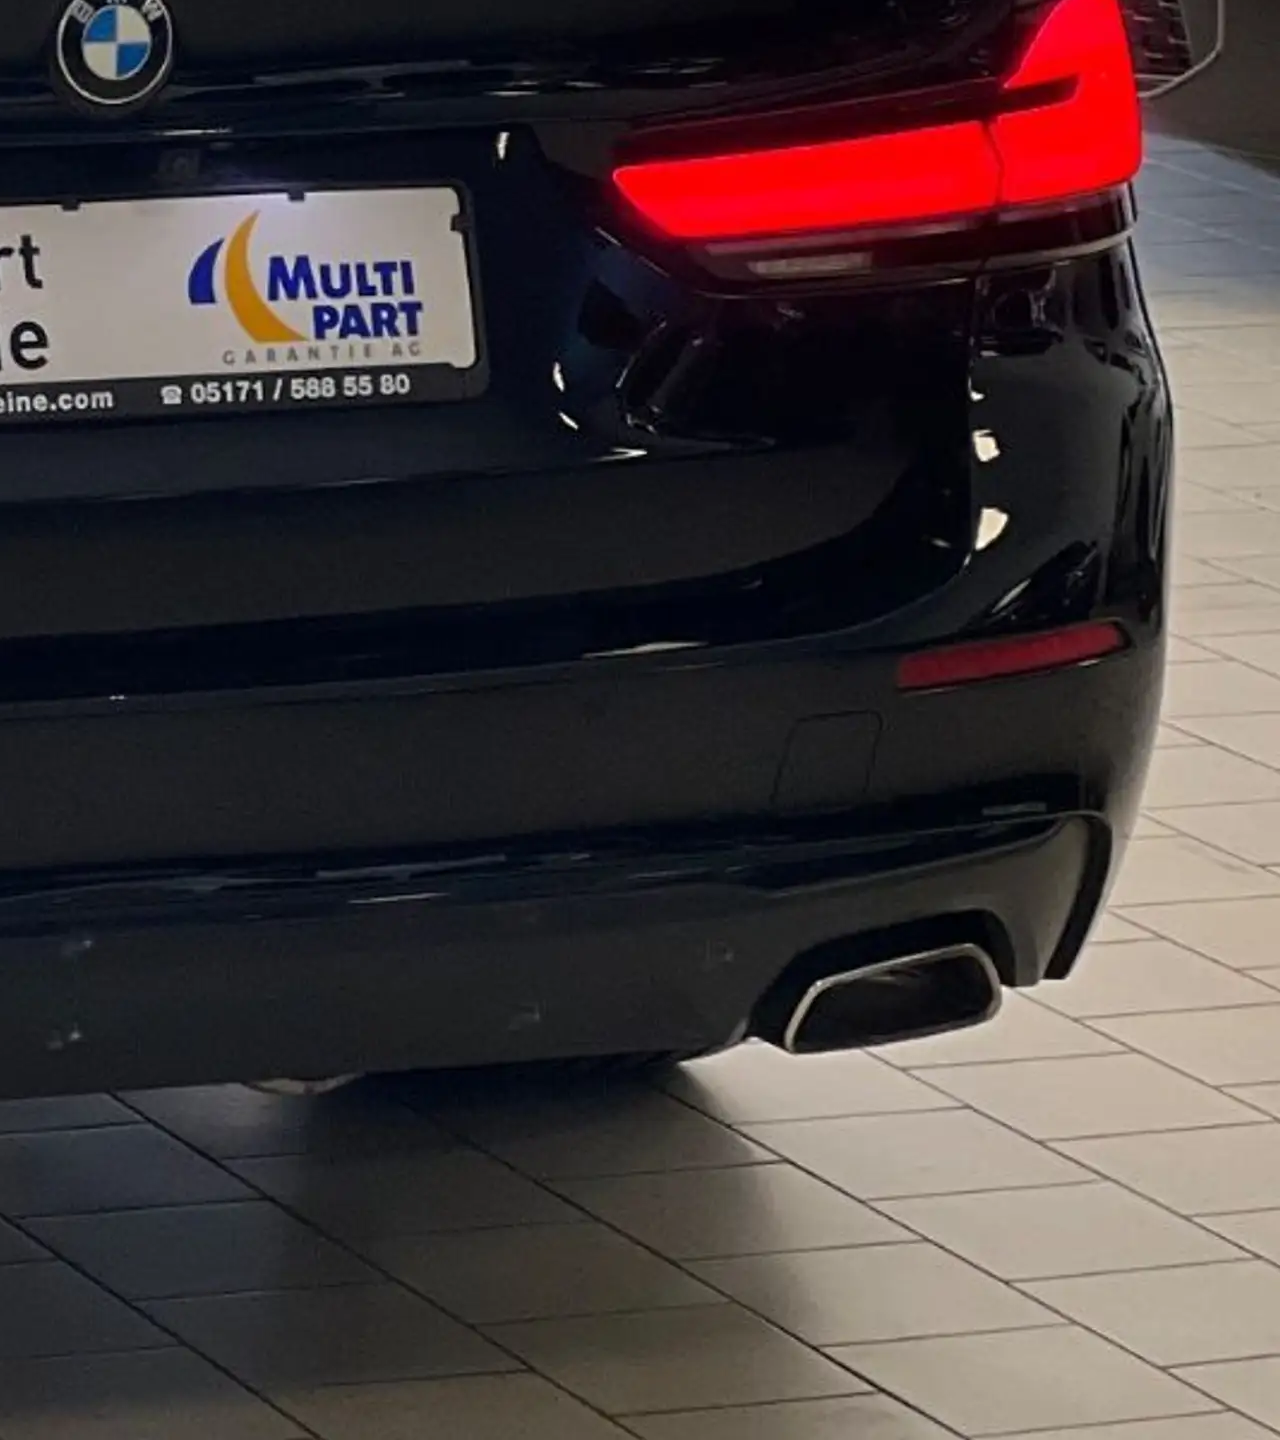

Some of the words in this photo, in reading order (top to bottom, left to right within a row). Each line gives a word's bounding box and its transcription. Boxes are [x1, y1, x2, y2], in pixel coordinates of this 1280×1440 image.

[268, 255, 415, 301] MULTI
[313, 301, 423, 340] PART
[222, 344, 373, 366] GARANTIE
[391, 340, 421, 357] AG
[190, 381, 264, 404] 05171
[290, 377, 335, 400] 588
[343, 375, 373, 397] 55
[379, 373, 410, 395] 80
